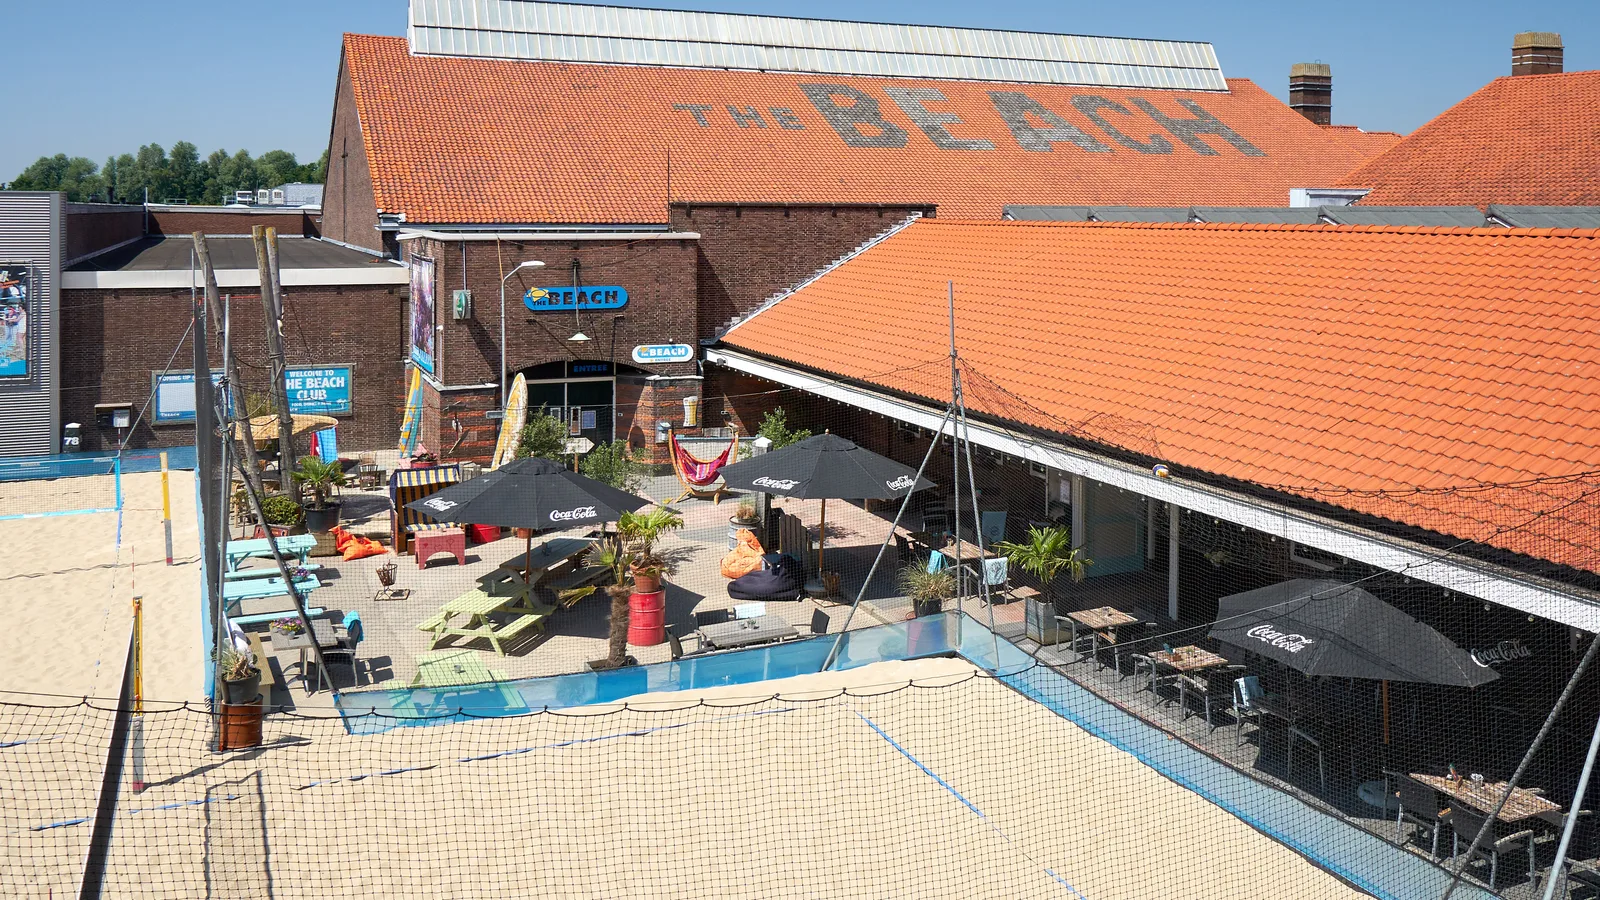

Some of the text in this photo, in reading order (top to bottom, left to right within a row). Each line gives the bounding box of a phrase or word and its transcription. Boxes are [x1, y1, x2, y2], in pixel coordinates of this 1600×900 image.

[672, 83, 1267, 157] THE BEACH
[548, 290, 618, 305] BEACH
[649, 348, 686, 357] BEACH
[289, 370, 323, 378] WELCOME
[573, 364, 608, 373] ENTREE
[285, 376, 345, 390] HE BEACH
[296, 389, 327, 401] CLUB
[64, 436, 79, 445] 78
[549, 505, 598, 522] Coca-Cola
[1246, 624, 1315, 654] Coca-Cola
[1470, 638, 1532, 668] Coca-Cola
